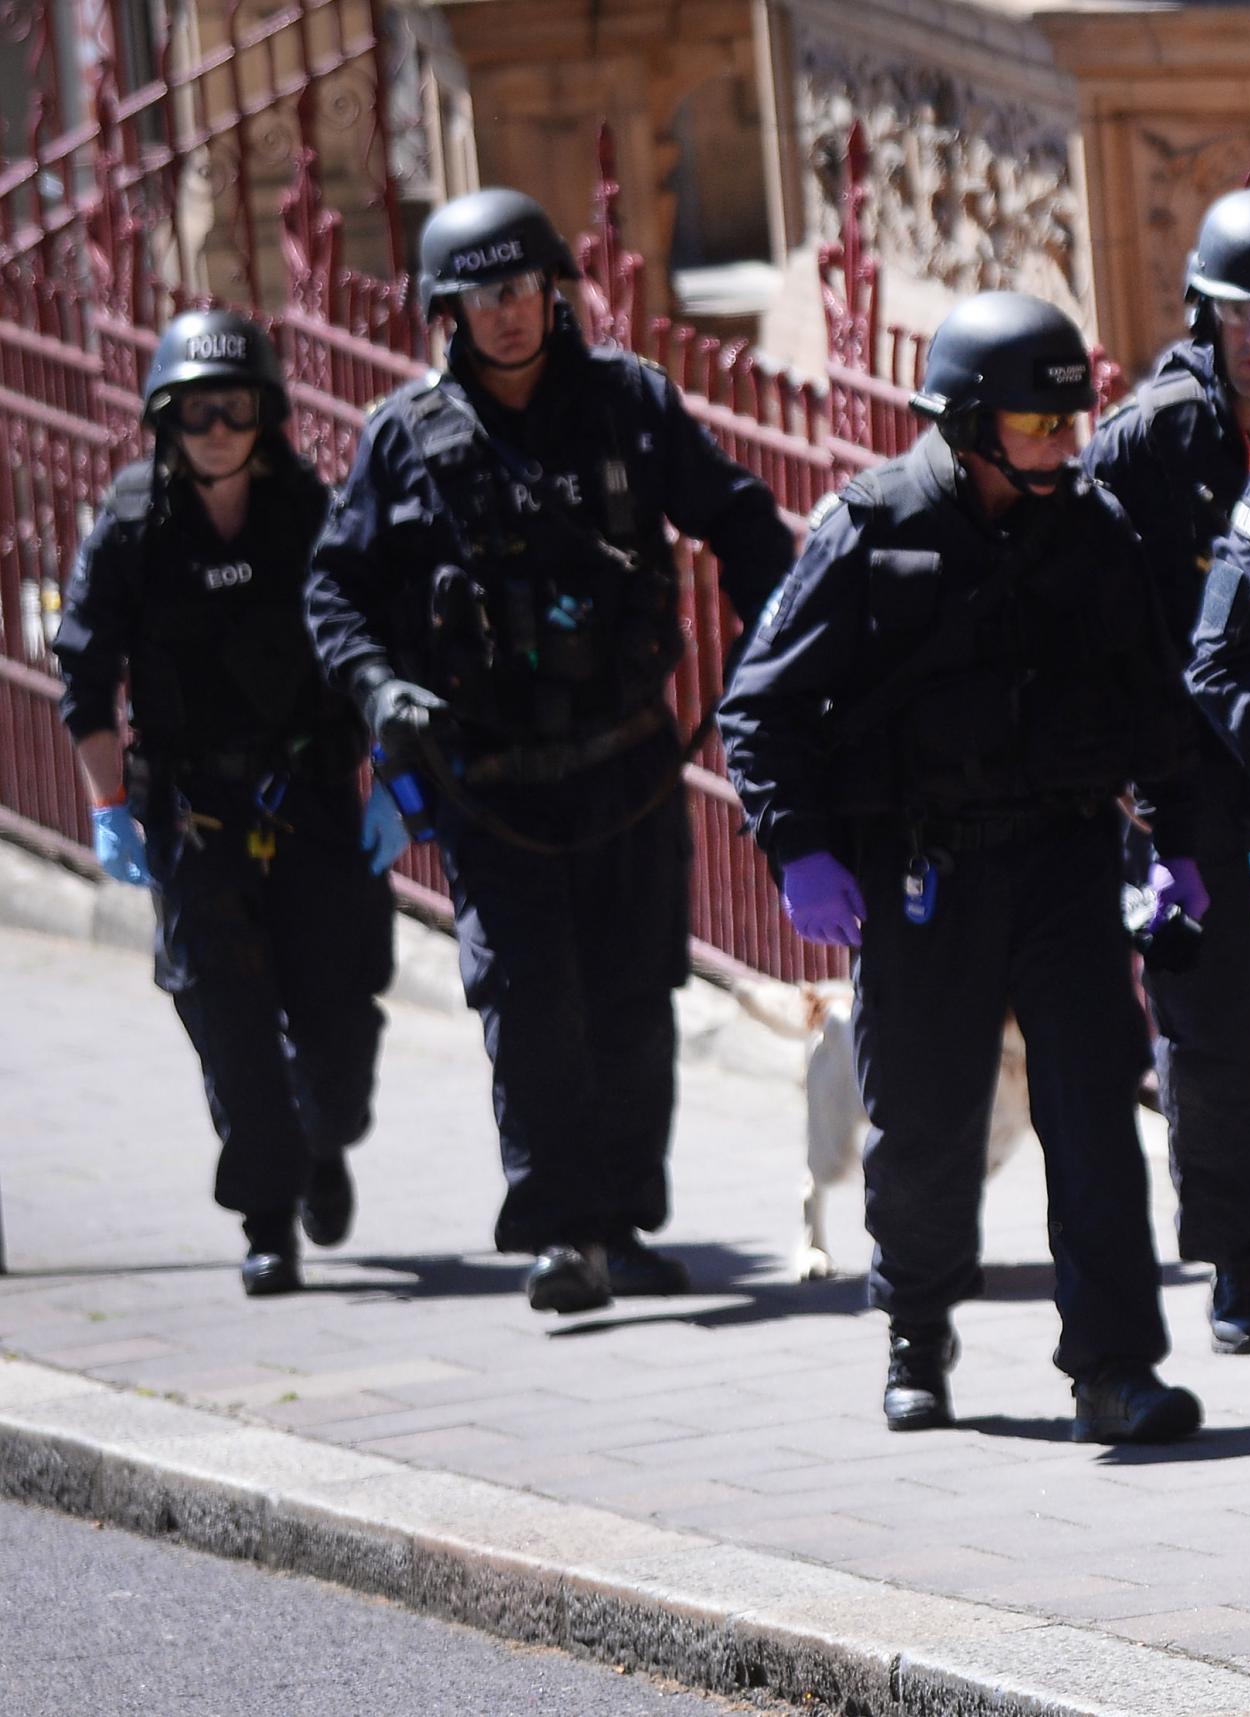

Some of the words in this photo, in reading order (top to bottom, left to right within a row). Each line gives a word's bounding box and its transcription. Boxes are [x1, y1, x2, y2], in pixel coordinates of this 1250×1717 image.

[453, 240, 524, 275] POLICE
[190, 334, 247, 360] POLICE
[512, 473, 583, 513] POCE
[207, 562, 253, 589] EOD
